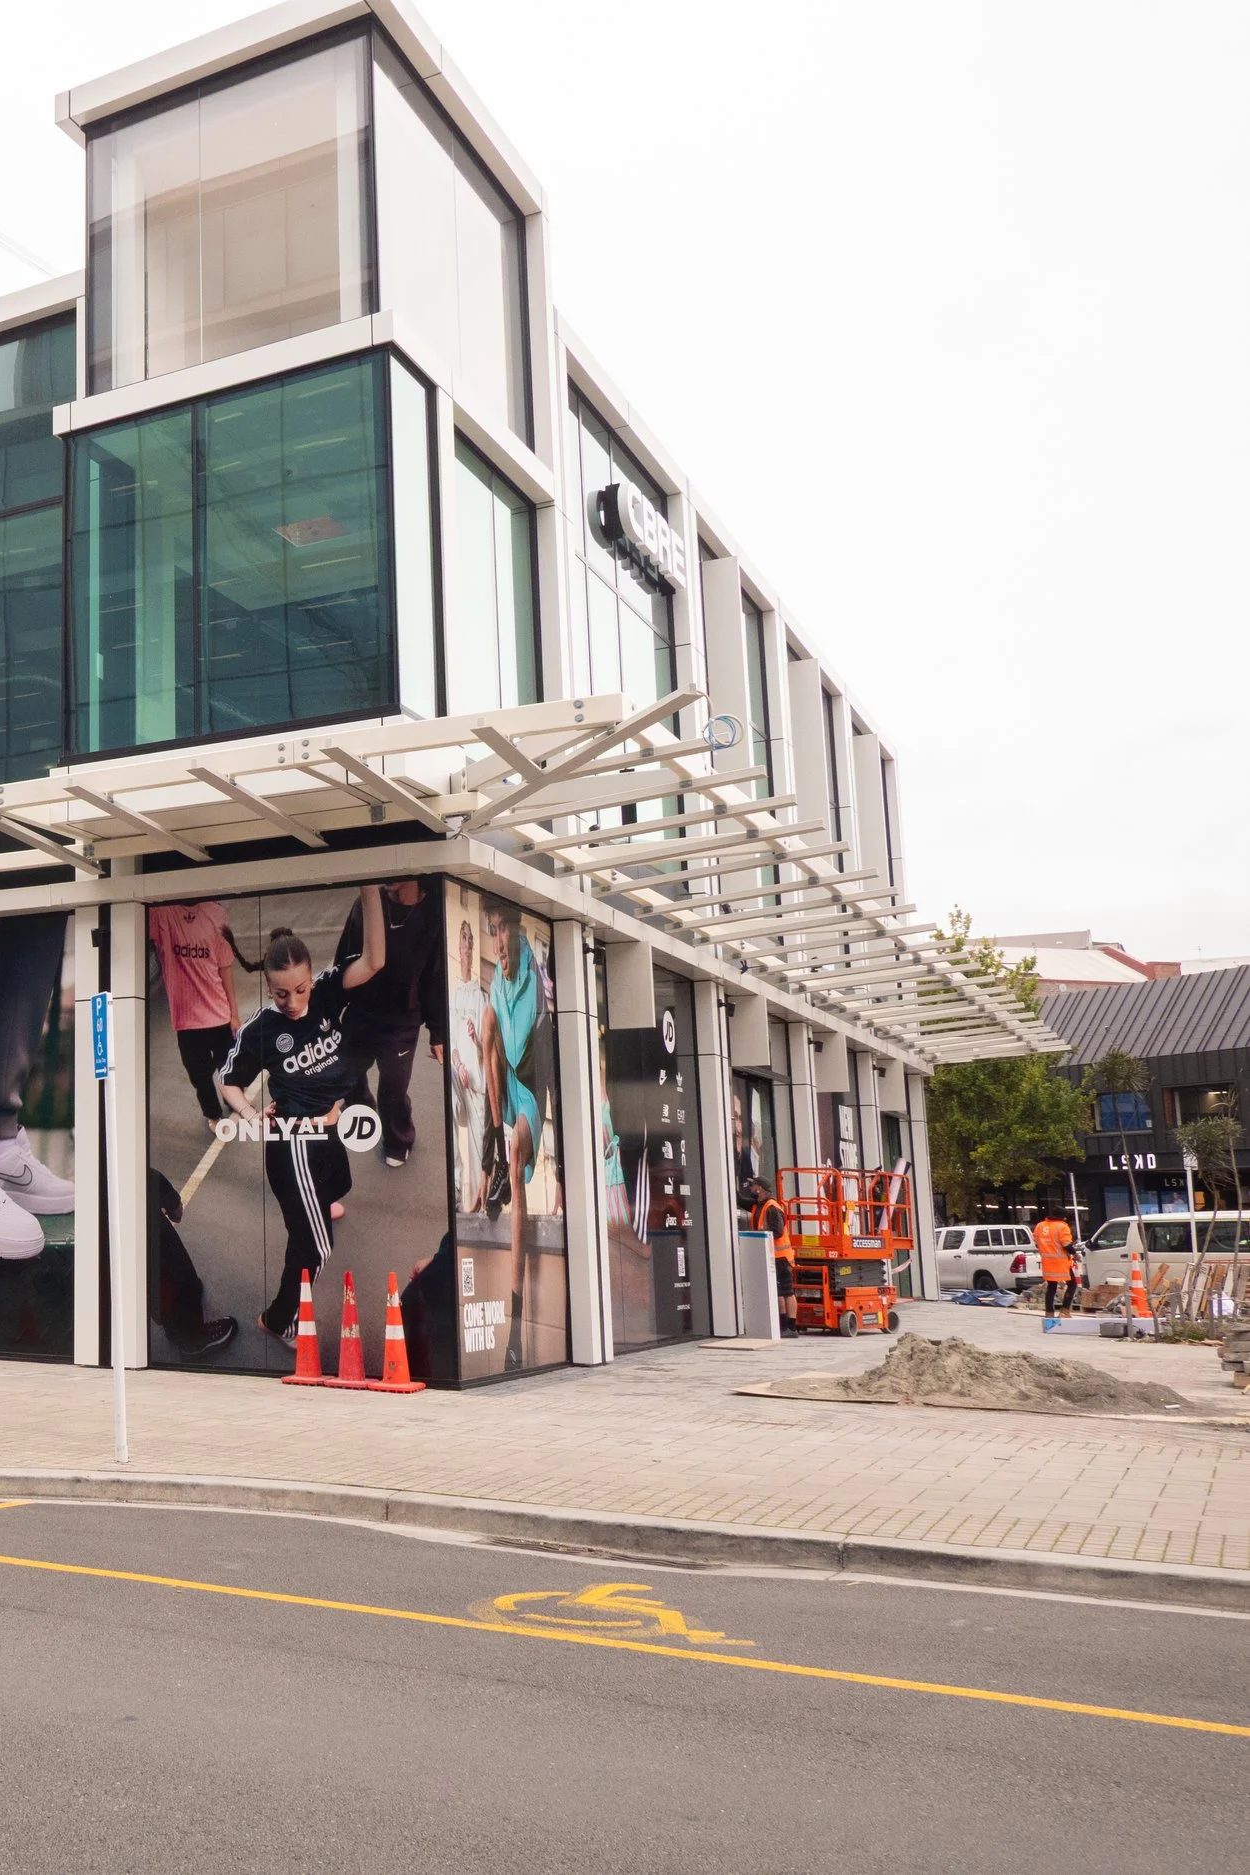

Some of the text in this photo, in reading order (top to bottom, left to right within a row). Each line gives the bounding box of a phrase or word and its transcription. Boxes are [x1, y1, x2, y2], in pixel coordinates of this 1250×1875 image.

[617, 481, 687, 590] CBRE
[174, 943, 211, 959] adidas
[96, 997, 102, 1016] P
[282, 1029, 343, 1075] adidas
[304, 1054, 339, 1076] originals
[214, 1116, 376, 1143] ONLY AT JD
[464, 1300, 506, 1328] COME WORK
[464, 1325, 496, 1353] WITH US
